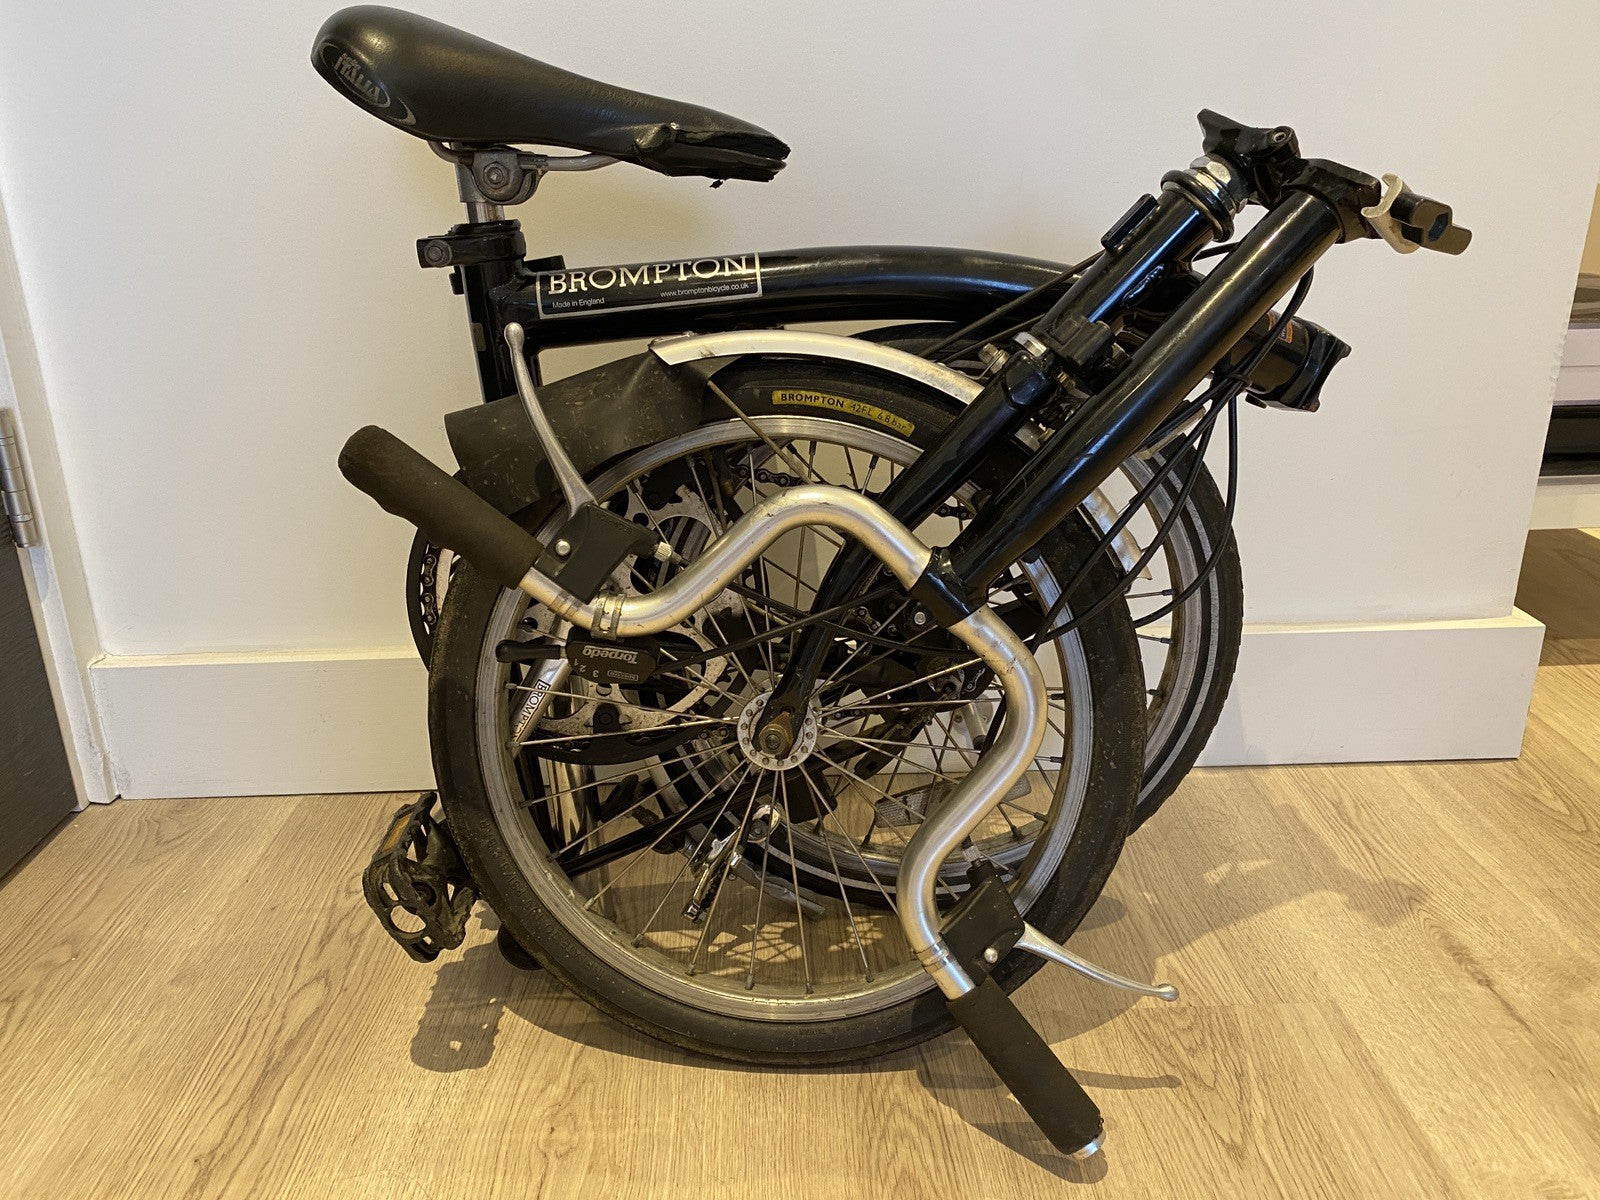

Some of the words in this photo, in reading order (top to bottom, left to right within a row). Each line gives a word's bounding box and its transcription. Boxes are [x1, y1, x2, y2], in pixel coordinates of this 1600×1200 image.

[548, 256, 748, 295] BROMPTON
[660, 282, 750, 298] www.bromptonbicycle.co.uk
[552, 301, 571, 309] Made
[571, 300, 579, 308] in
[578, 297, 605, 308] England
[780, 393, 845, 408] BROMPTON
[582, 646, 639, 665] Torpedo
[579, 664, 586, 672] 2
[592, 670, 599, 678] 3
[512, 683, 548, 738] BROMPTO
